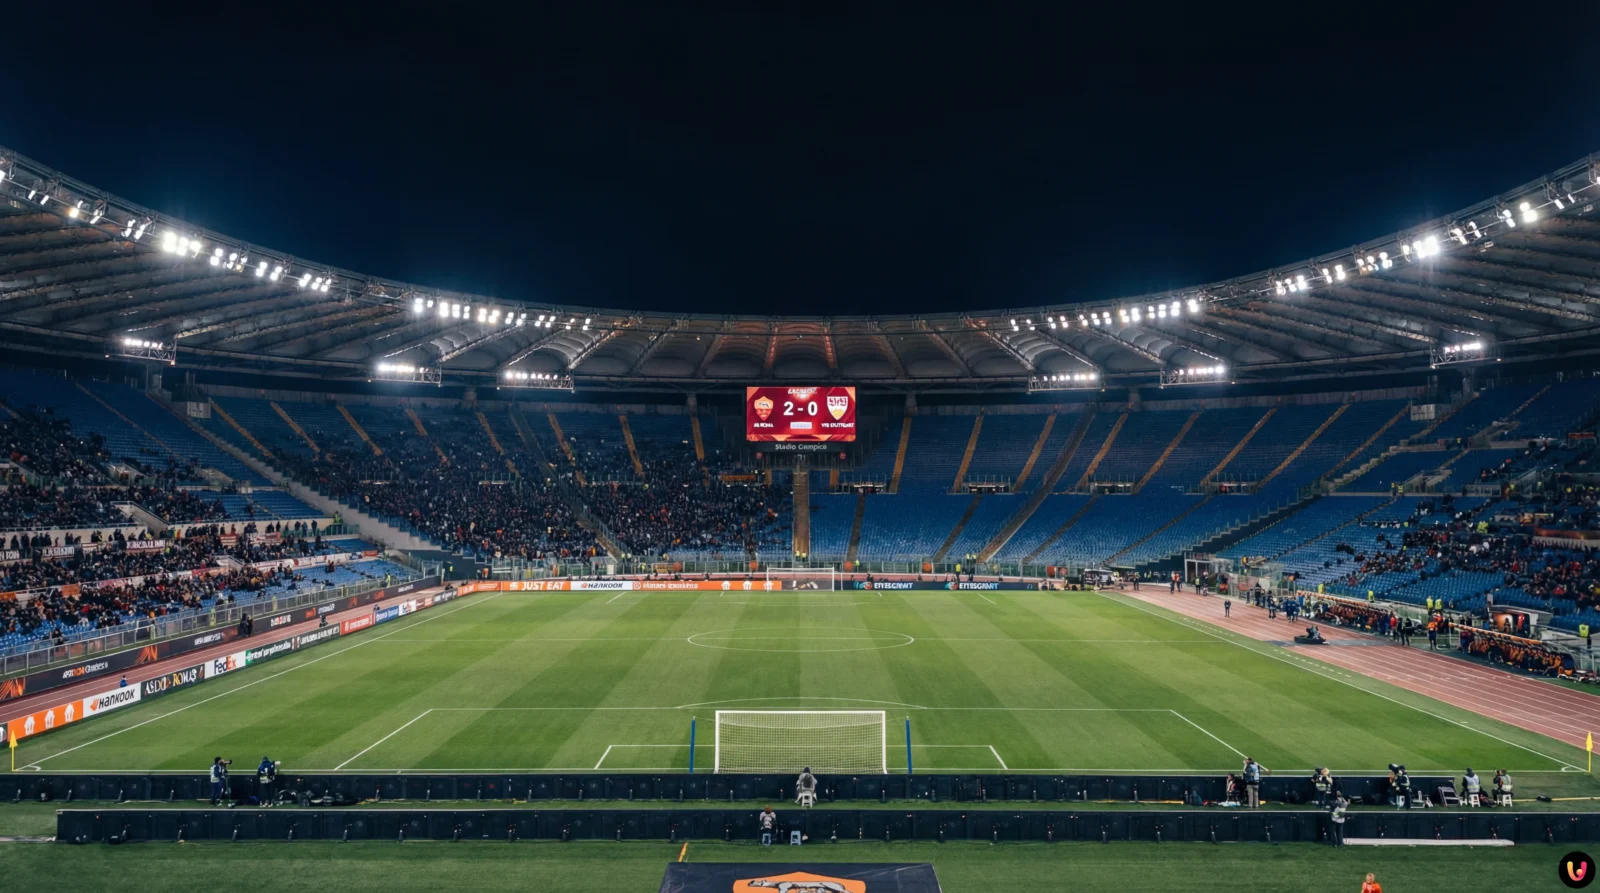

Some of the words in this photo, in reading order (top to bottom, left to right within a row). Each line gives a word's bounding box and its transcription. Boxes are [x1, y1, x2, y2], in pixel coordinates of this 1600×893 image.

[783, 401, 794, 416] 2
[807, 401, 818, 416] 0
[521, 581, 544, 591] JUST
[546, 581, 564, 590] EAT
[214, 655, 236, 675] FedEx
